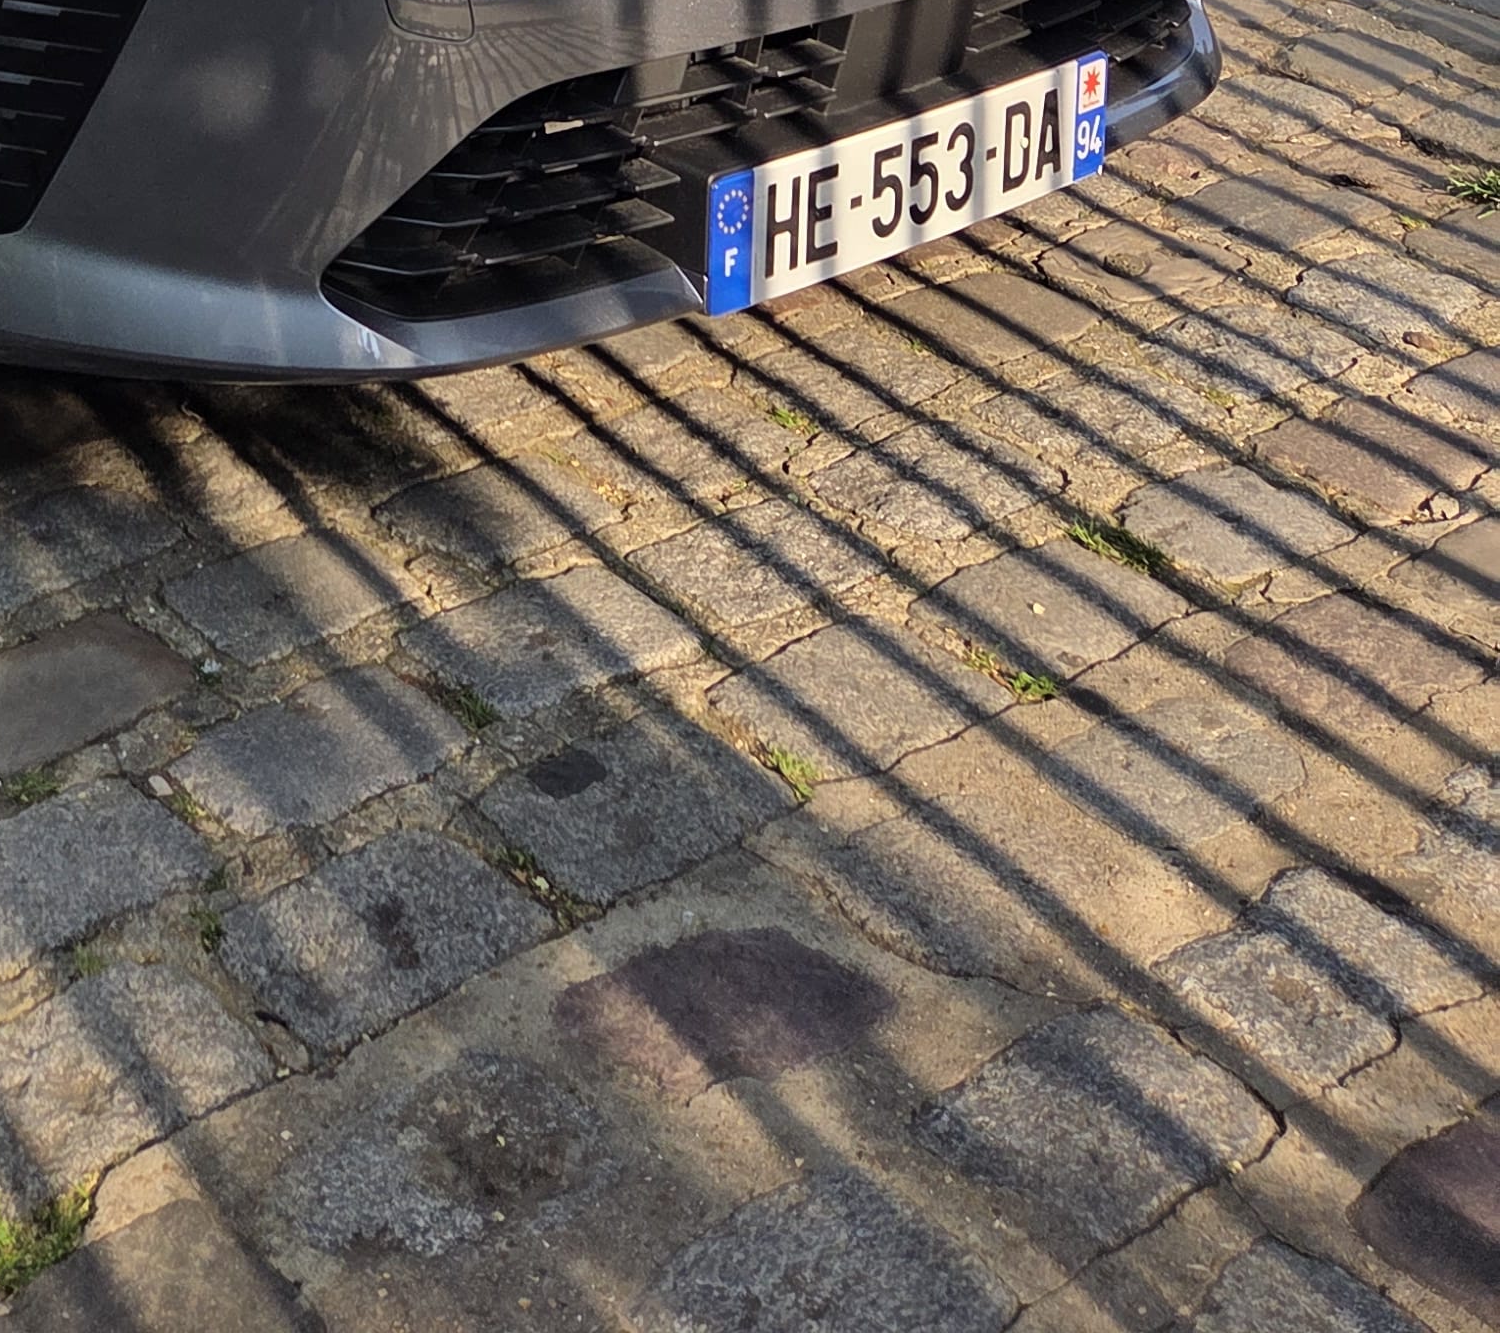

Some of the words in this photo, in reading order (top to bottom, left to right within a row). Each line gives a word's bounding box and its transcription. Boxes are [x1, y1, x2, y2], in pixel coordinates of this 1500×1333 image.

[1076, 114, 1102, 160] 94
[765, 89, 1062, 279] HE-553-DA
[723, 247, 738, 277] F
